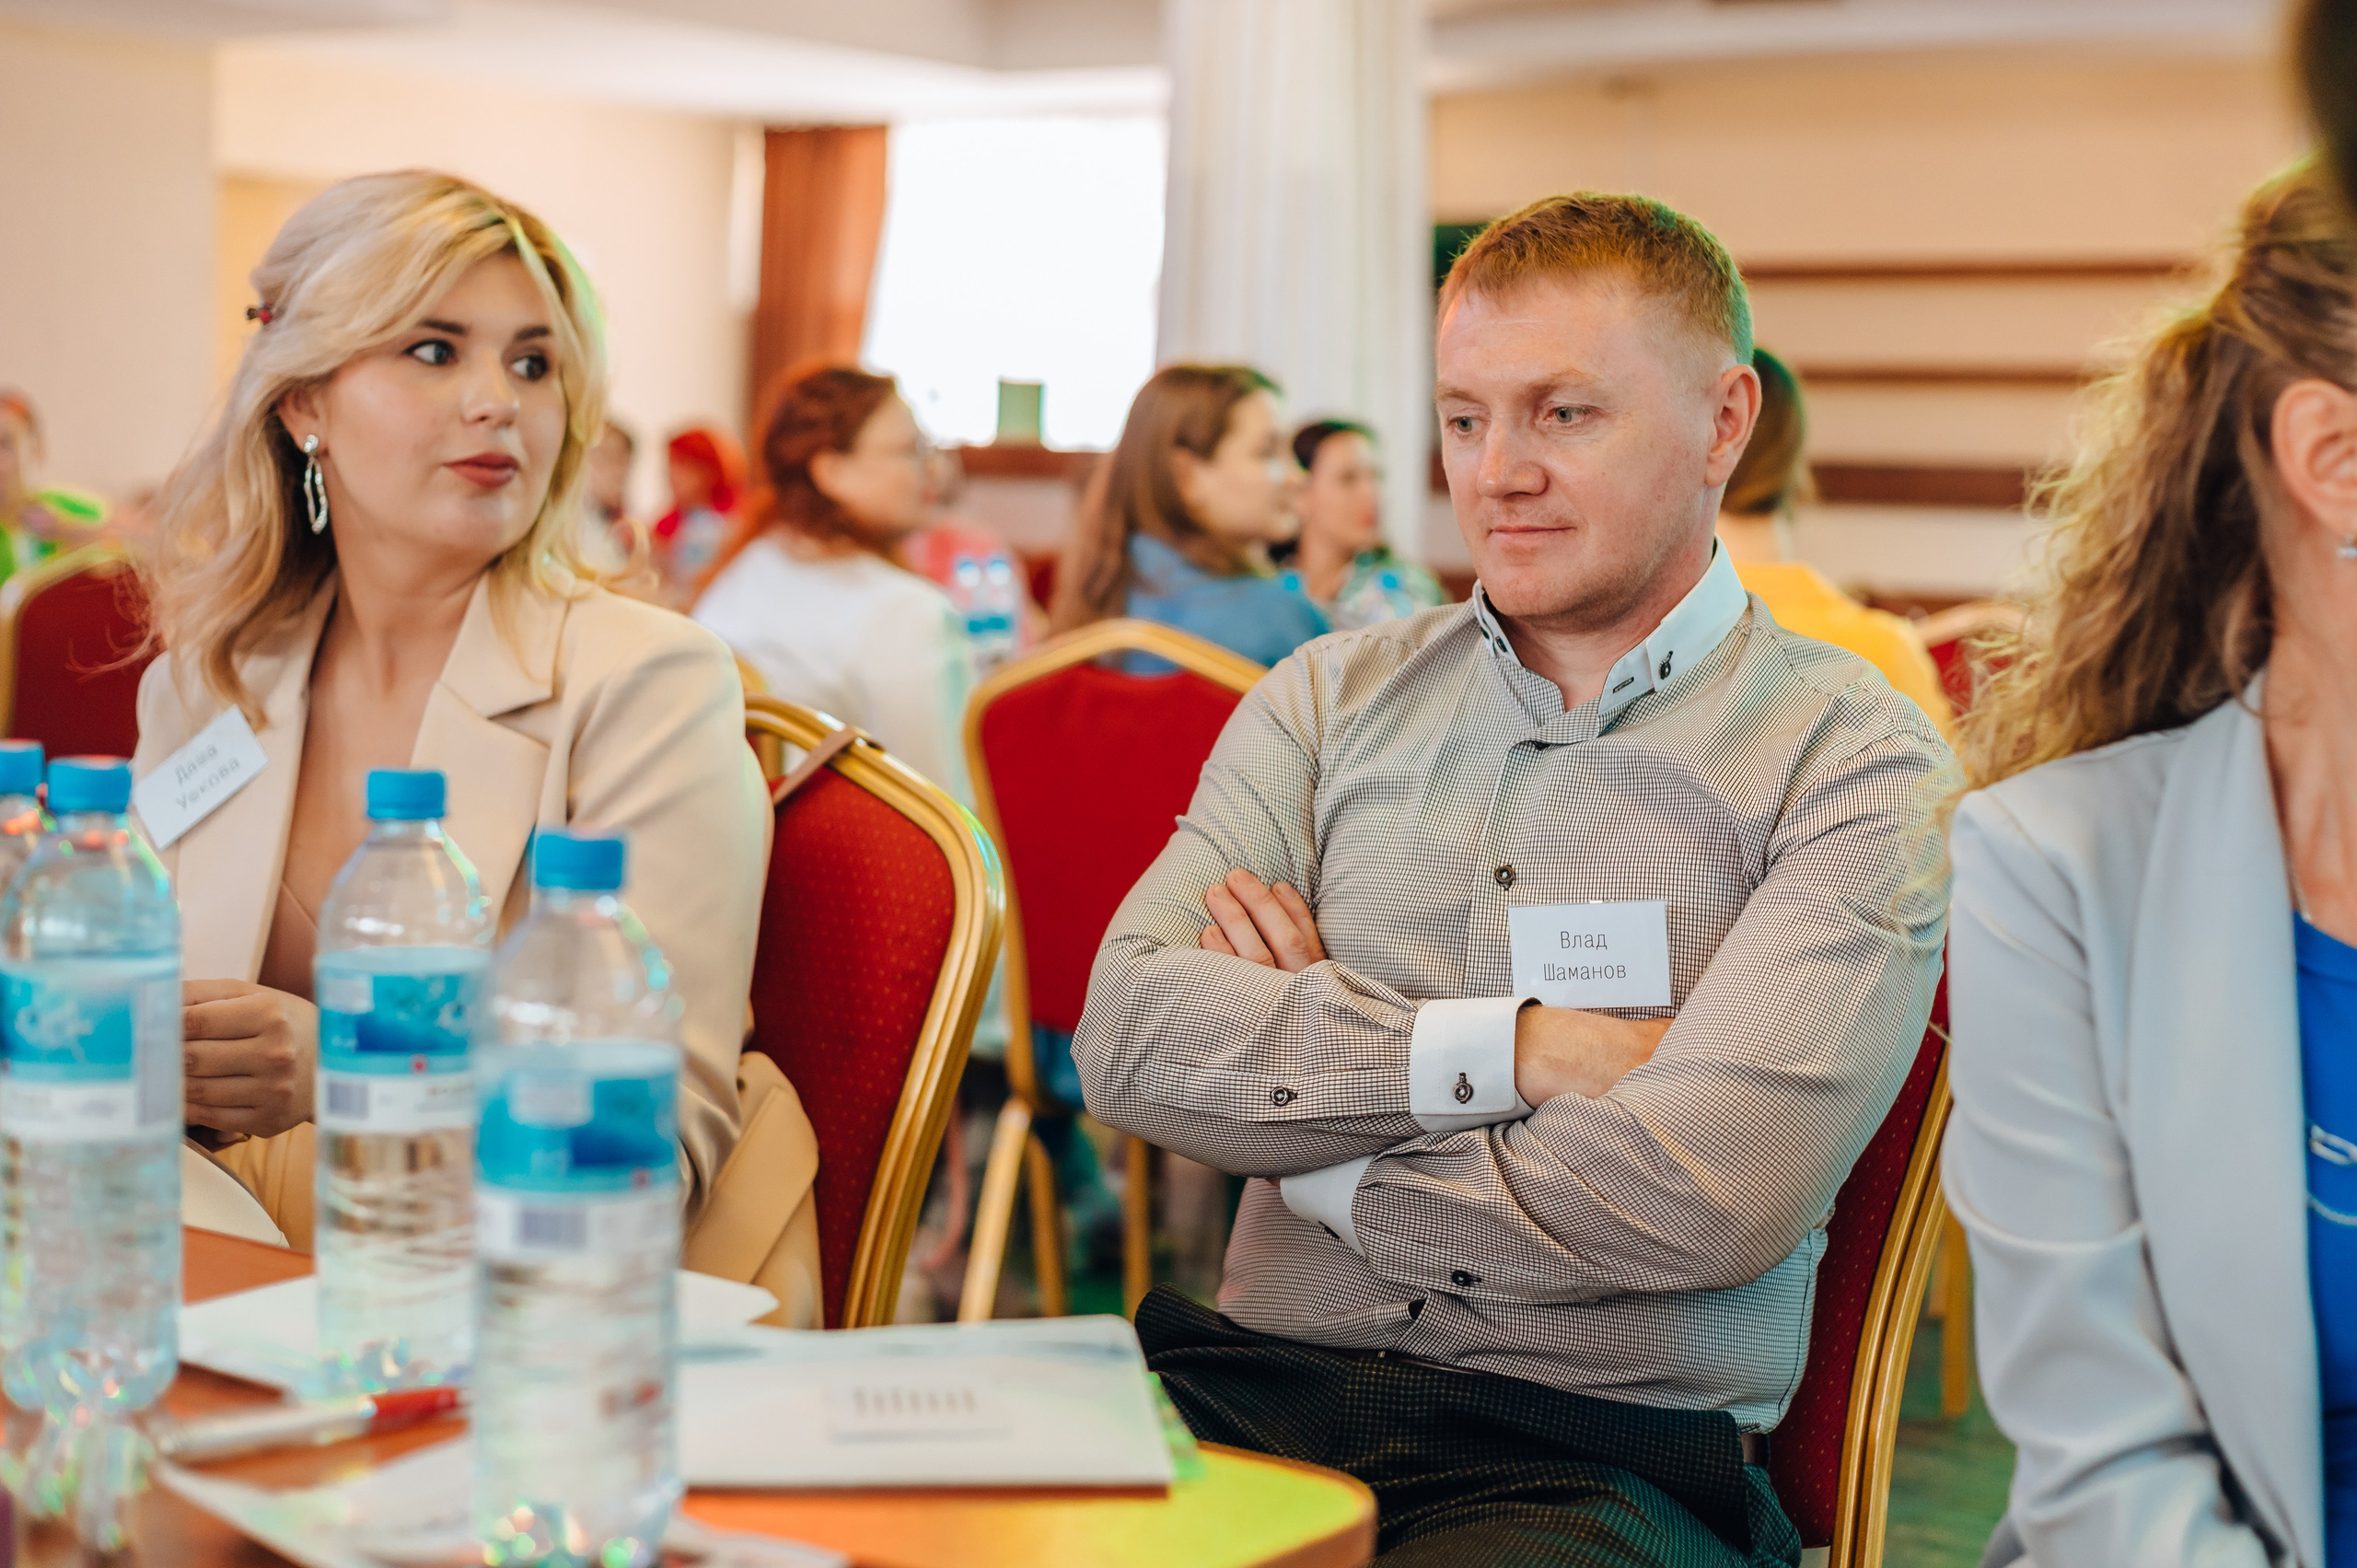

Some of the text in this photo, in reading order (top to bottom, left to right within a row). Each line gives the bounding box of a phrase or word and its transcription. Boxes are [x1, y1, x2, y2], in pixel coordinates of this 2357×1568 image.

[174, 743, 218, 785] Даша
[1560, 930, 1608, 951] Влад
[1543, 962, 1627, 981] Шаманов
